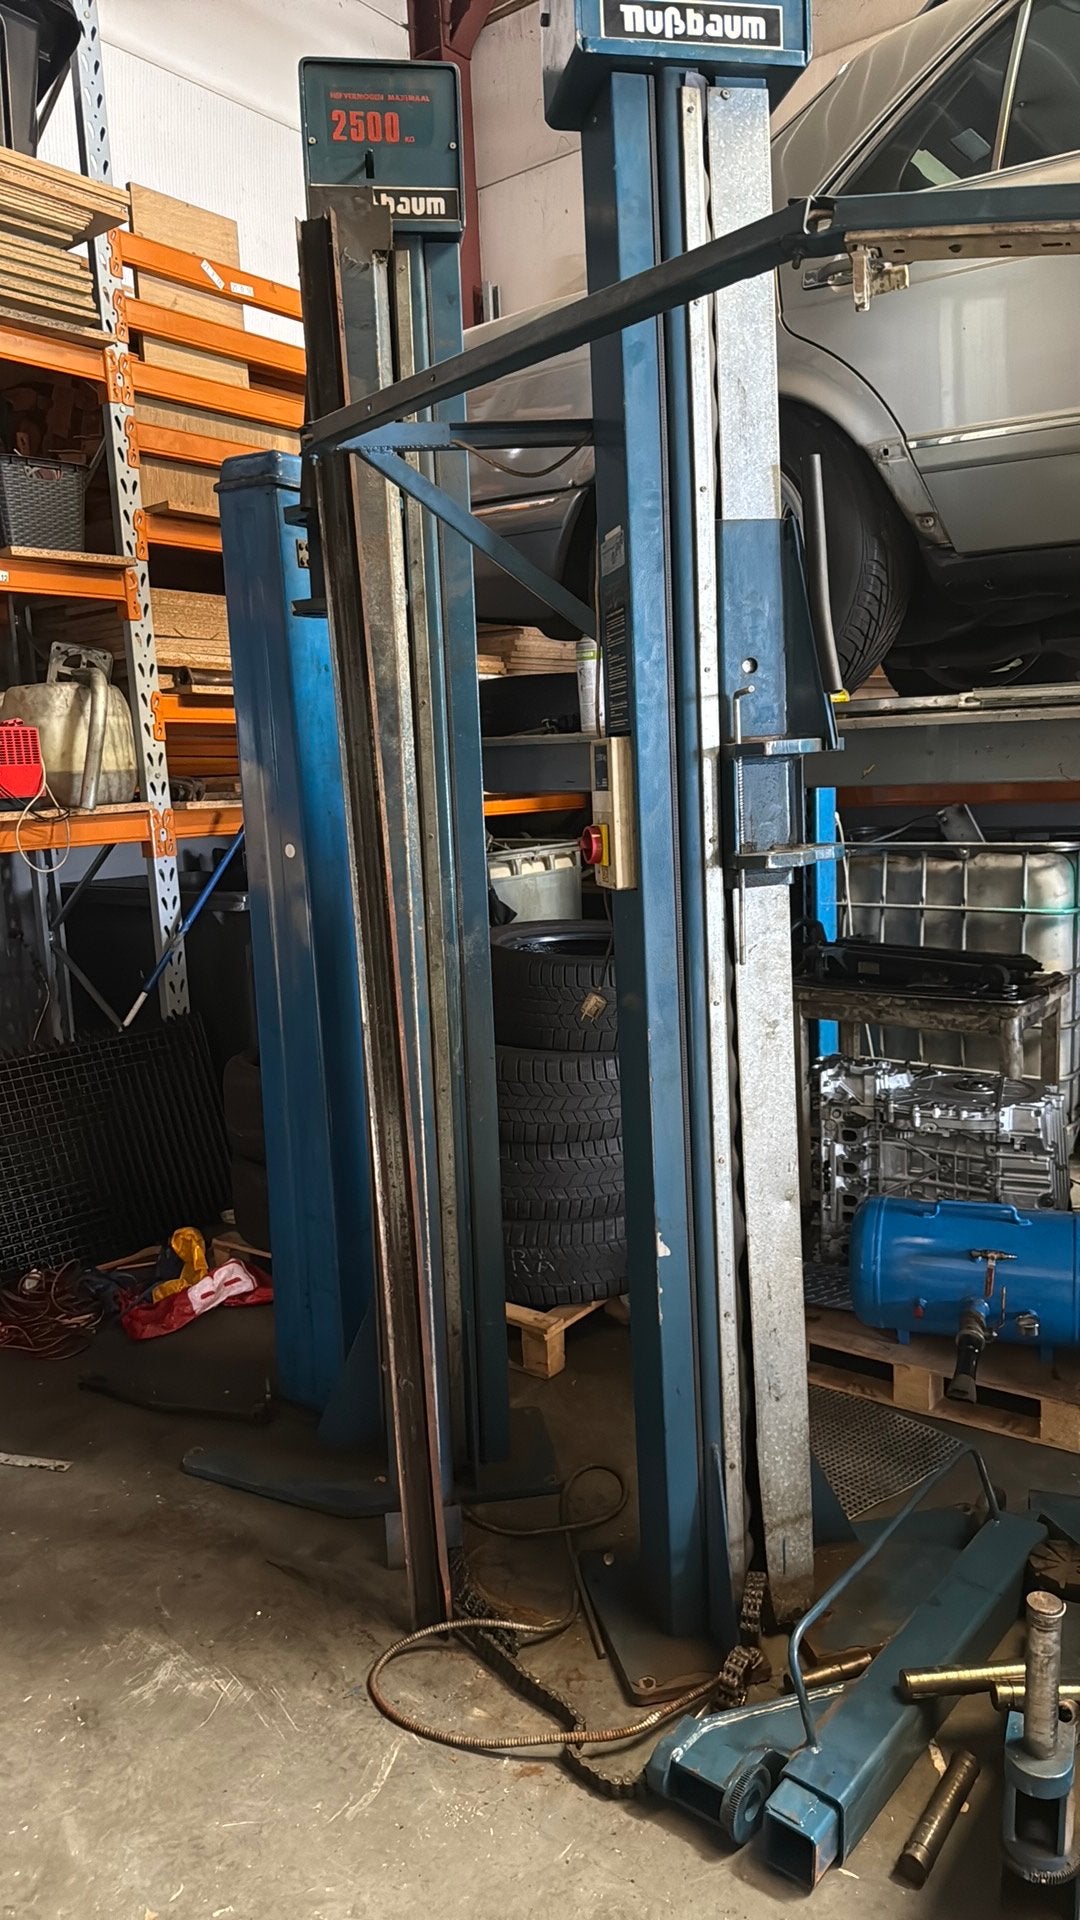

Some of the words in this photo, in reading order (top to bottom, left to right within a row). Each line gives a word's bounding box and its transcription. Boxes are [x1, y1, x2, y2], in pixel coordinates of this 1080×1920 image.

[620, 5, 766, 40] Nußbaum
[331, 109, 400, 143] 2500
[372, 193, 446, 216] baum
